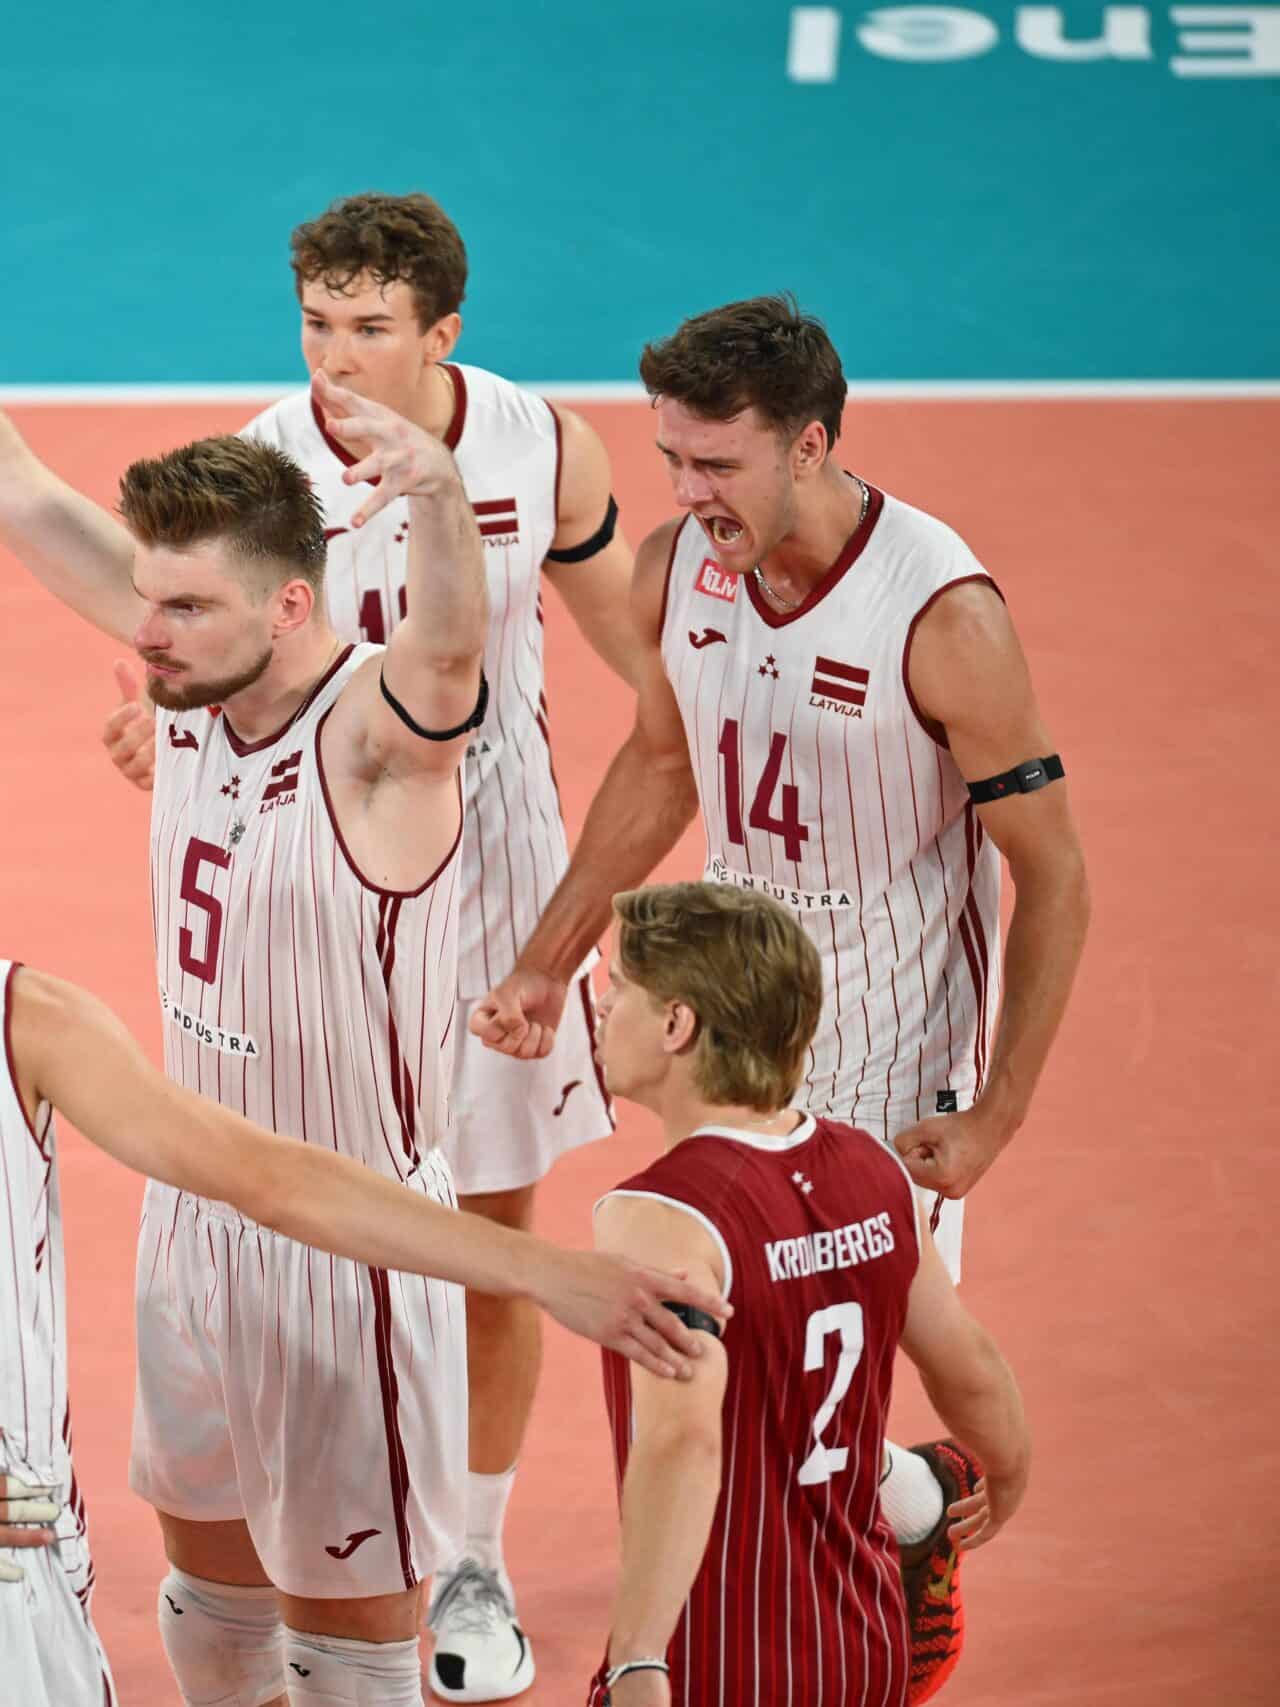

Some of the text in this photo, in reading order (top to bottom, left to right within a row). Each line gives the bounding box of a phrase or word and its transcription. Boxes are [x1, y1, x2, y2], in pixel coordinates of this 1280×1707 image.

[787, 5, 1280, 83] Enel
[481, 537, 519, 547] TVIJA
[809, 696, 862, 719] LATVIJA
[718, 718, 809, 862] 14
[179, 836, 231, 984] 5
[173, 1007, 257, 1054] NDUSTRA
[764, 1212, 895, 1282] KROBERGS
[797, 1301, 864, 1486] 2
